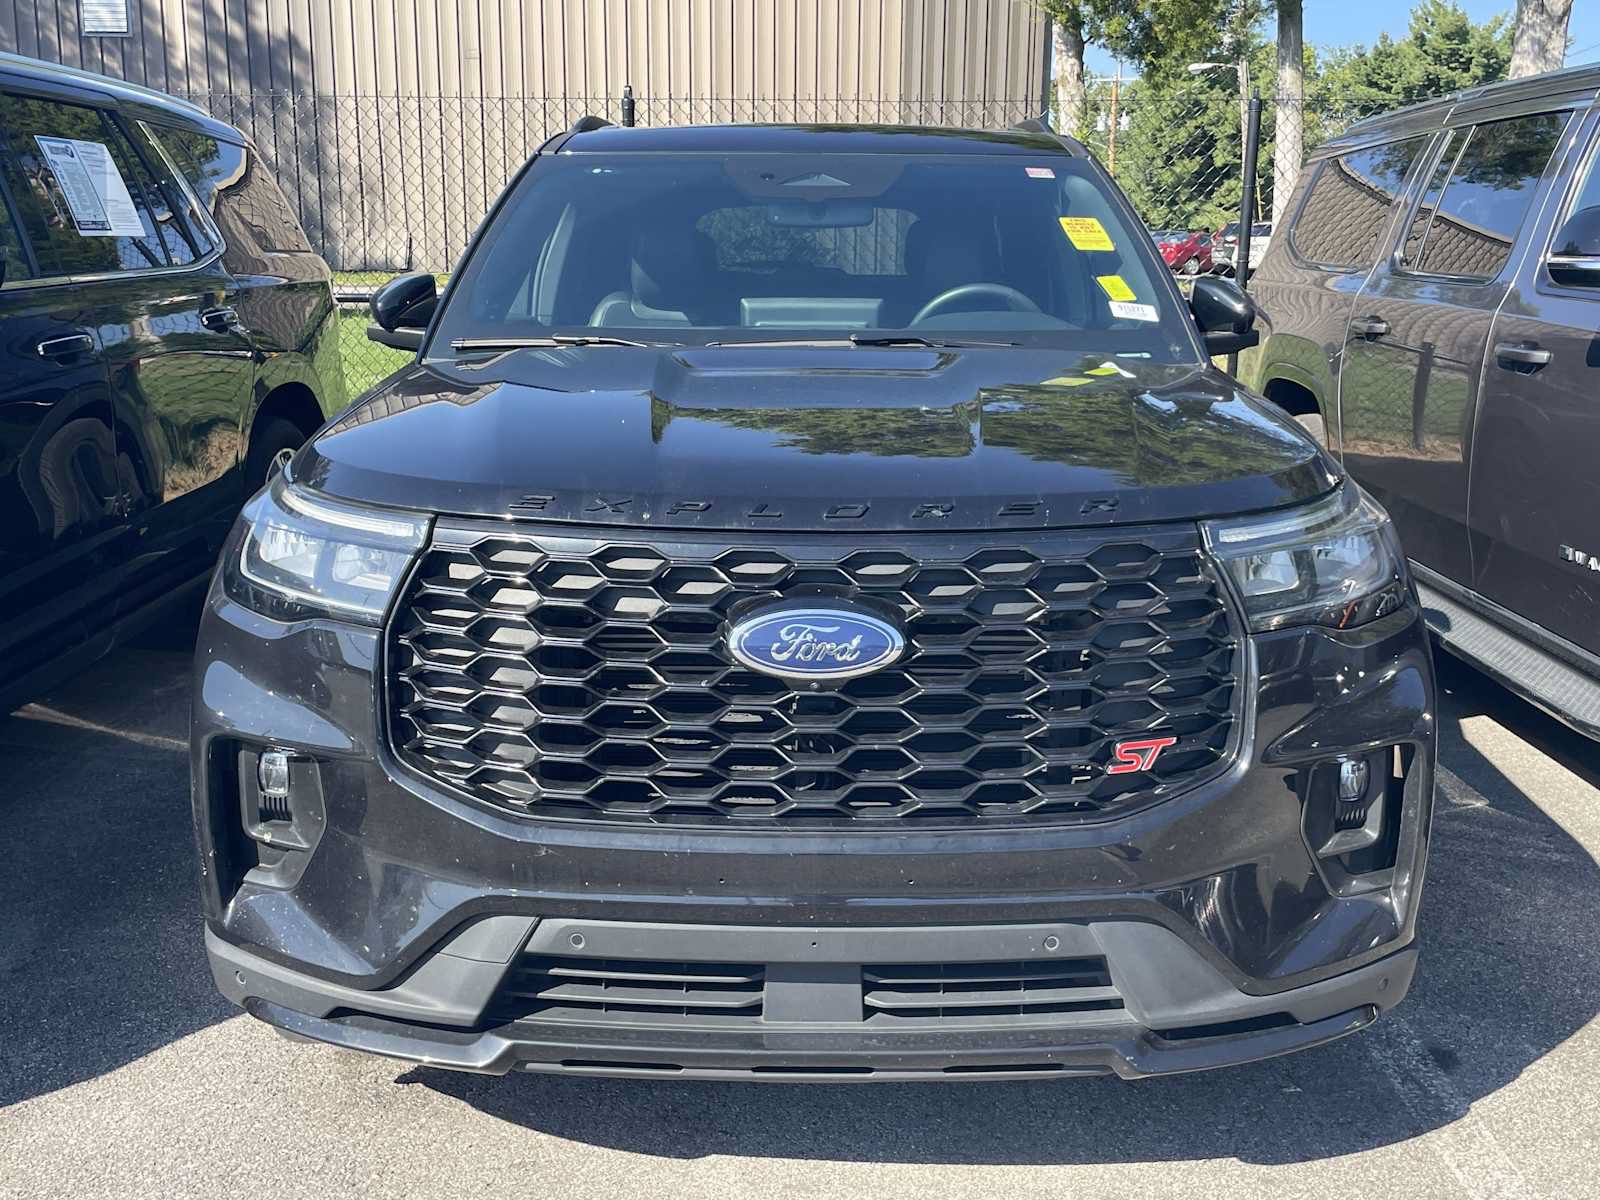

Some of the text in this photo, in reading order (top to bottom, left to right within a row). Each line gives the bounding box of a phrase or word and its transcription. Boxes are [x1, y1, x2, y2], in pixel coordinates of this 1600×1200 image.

[509, 495, 1120, 518] EXPLORER
[771, 623, 863, 662] Ford
[1106, 737, 1177, 774] ST
